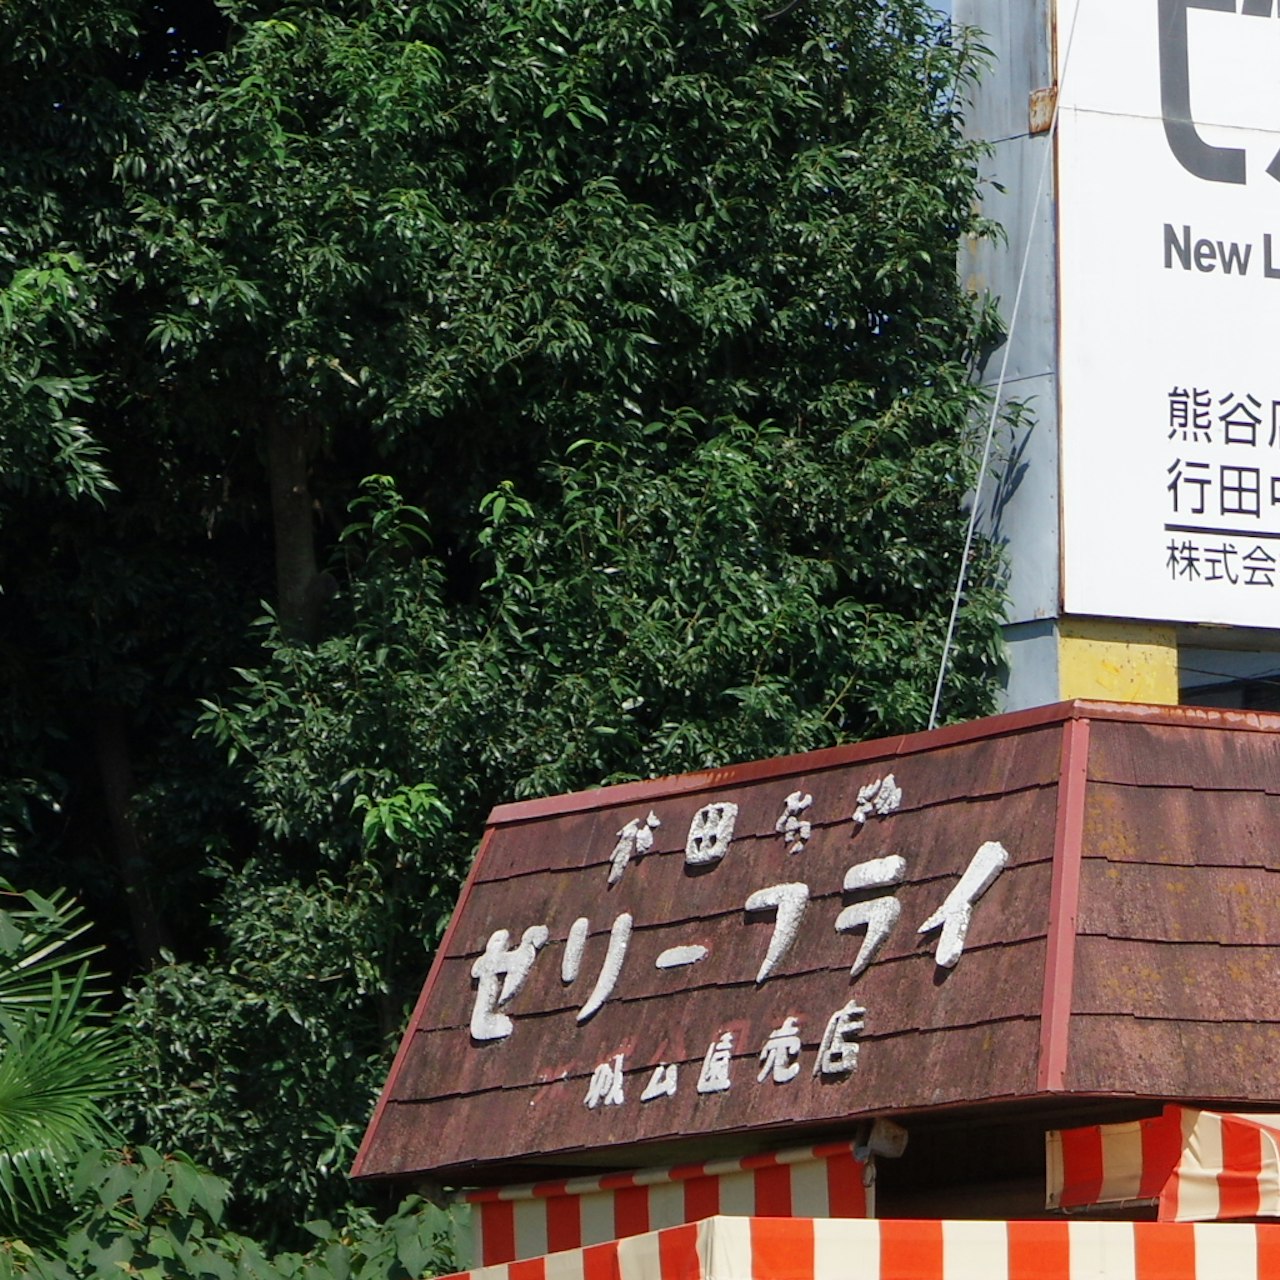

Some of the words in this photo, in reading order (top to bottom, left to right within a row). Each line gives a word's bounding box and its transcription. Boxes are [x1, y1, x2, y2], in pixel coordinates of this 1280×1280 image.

[1163, 223, 1252, 276] New
[470, 841, 1009, 1041] ゼリーフライ
